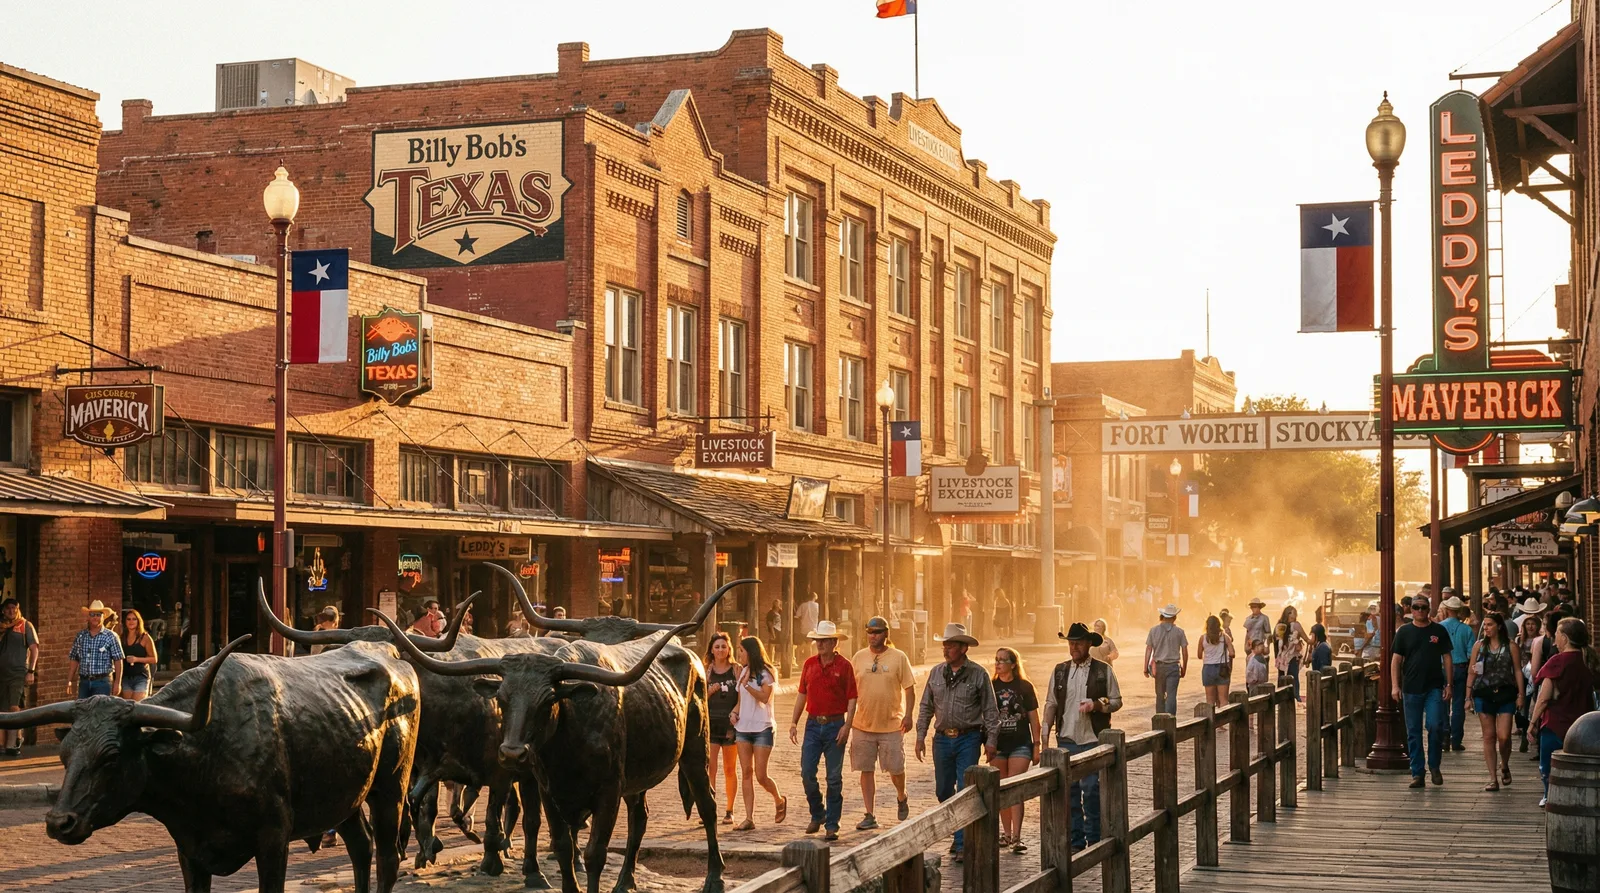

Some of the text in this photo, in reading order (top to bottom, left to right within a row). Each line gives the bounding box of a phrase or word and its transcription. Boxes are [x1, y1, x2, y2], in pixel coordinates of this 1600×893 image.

[408, 133, 527, 167] Billy Bob's
[377, 167, 554, 255] TEXAS
[366, 339, 417, 363] Billy Bob's
[365, 364, 417, 380] TEXAS
[1392, 379, 1562, 421] MAVERICK
[70, 398, 149, 432] MAVERICK
[1110, 424, 1169, 446] FORT
[1179, 422, 1259, 445] WORTH
[701, 438, 765, 450] LIVESTOCK
[702, 451, 765, 462] EXCHANGE
[938, 477, 1014, 488] LIVESTOCK
[938, 489, 1013, 499] EXCHANGE
[461, 540, 505, 555] LEDDY'S
[136, 557, 167, 572] OPEN
